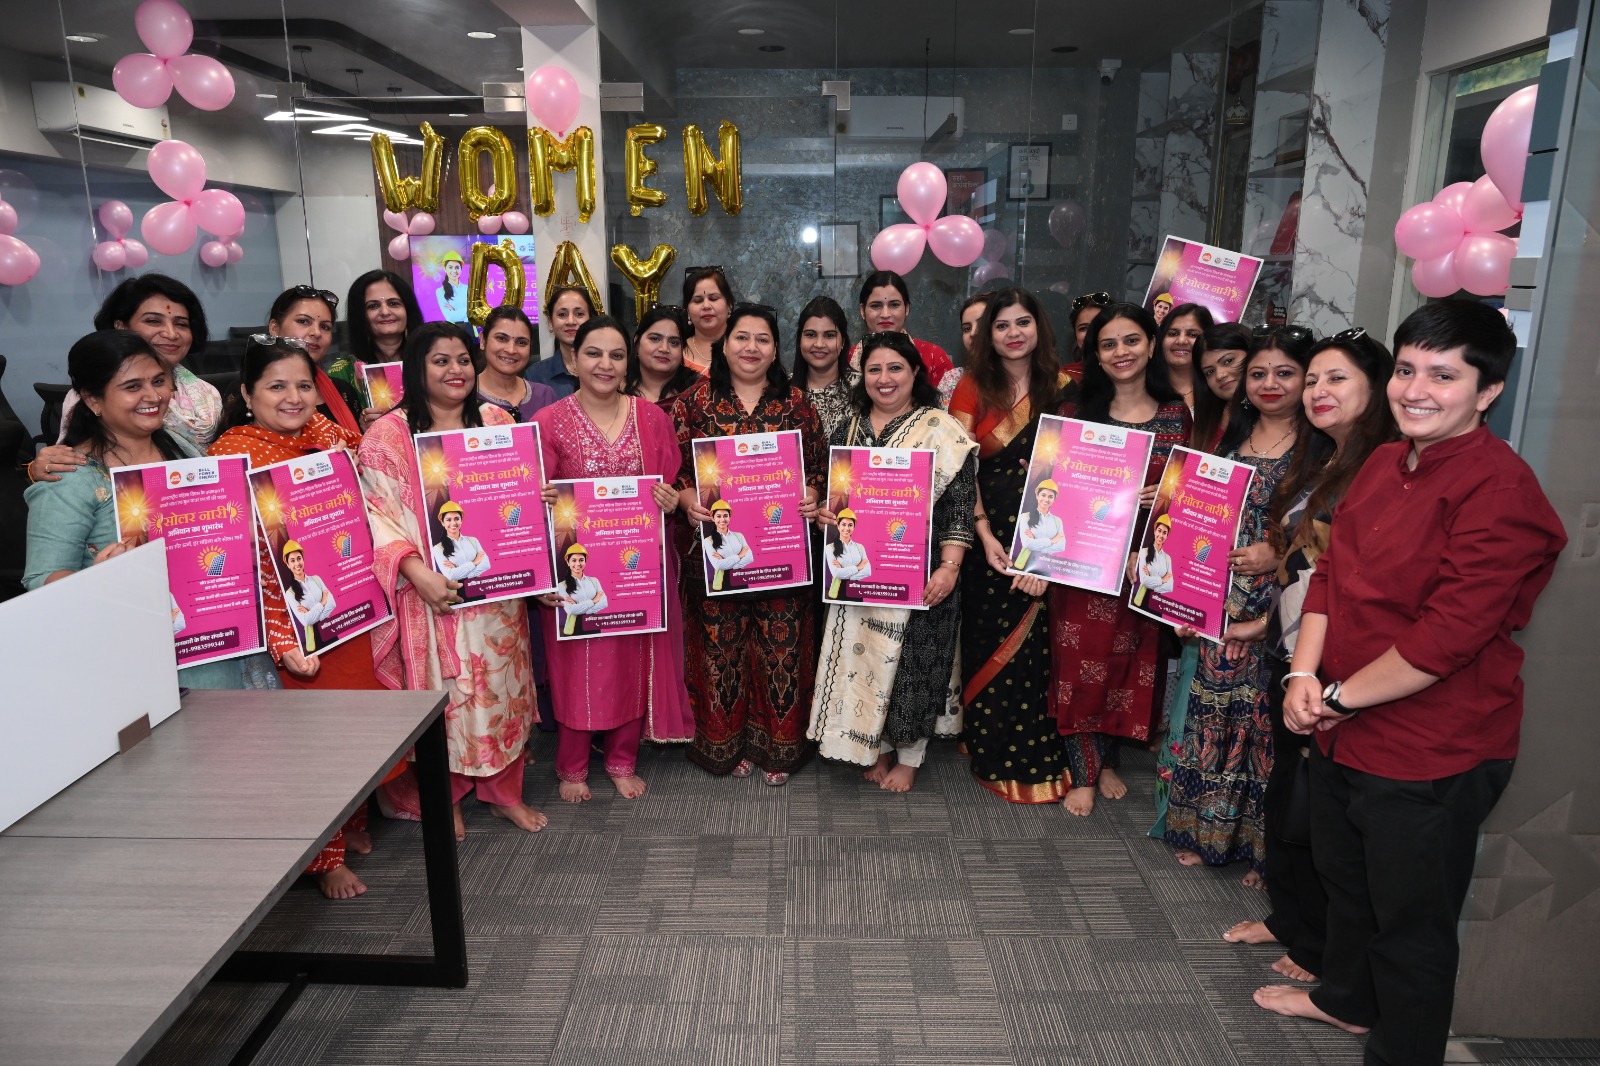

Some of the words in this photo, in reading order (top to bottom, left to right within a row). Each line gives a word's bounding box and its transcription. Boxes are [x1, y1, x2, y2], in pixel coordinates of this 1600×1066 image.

[370, 119, 743, 224] WOMEN
[467, 238, 677, 327] DAY
[1185, 277, 1212, 290] सोलर
[1211, 285, 1232, 296] नारी
[463, 471, 495, 483] सोलर
[496, 465, 521, 478] नारी
[733, 473, 761, 484] सोलर
[762, 469, 784, 481] नारी
[1069, 459, 1099, 473] सोलर
[1099, 466, 1123, 478] नारी
[499, 480, 518, 489] शुभारंभ
[862, 484, 890, 496] सोलर
[891, 486, 912, 497] नारी
[295, 501, 323, 518] सोलर
[324, 492, 345, 509] नारी
[1182, 493, 1206, 510] सोलर
[1205, 503, 1223, 516] नारी
[162, 512, 197, 526] सोलर
[198, 504, 226, 520] नारी
[303, 516, 322, 527] अभियान
[328, 508, 344, 519] शुभारंभ
[590, 517, 619, 528] सोलर
[620, 514, 643, 525] नारी
[169, 527, 193, 536] अभियान
[202, 521, 223, 532] शुभारंभ
[622, 527, 639, 535] शुभारंभ
[178, 641, 224, 654] +91-9983599340
